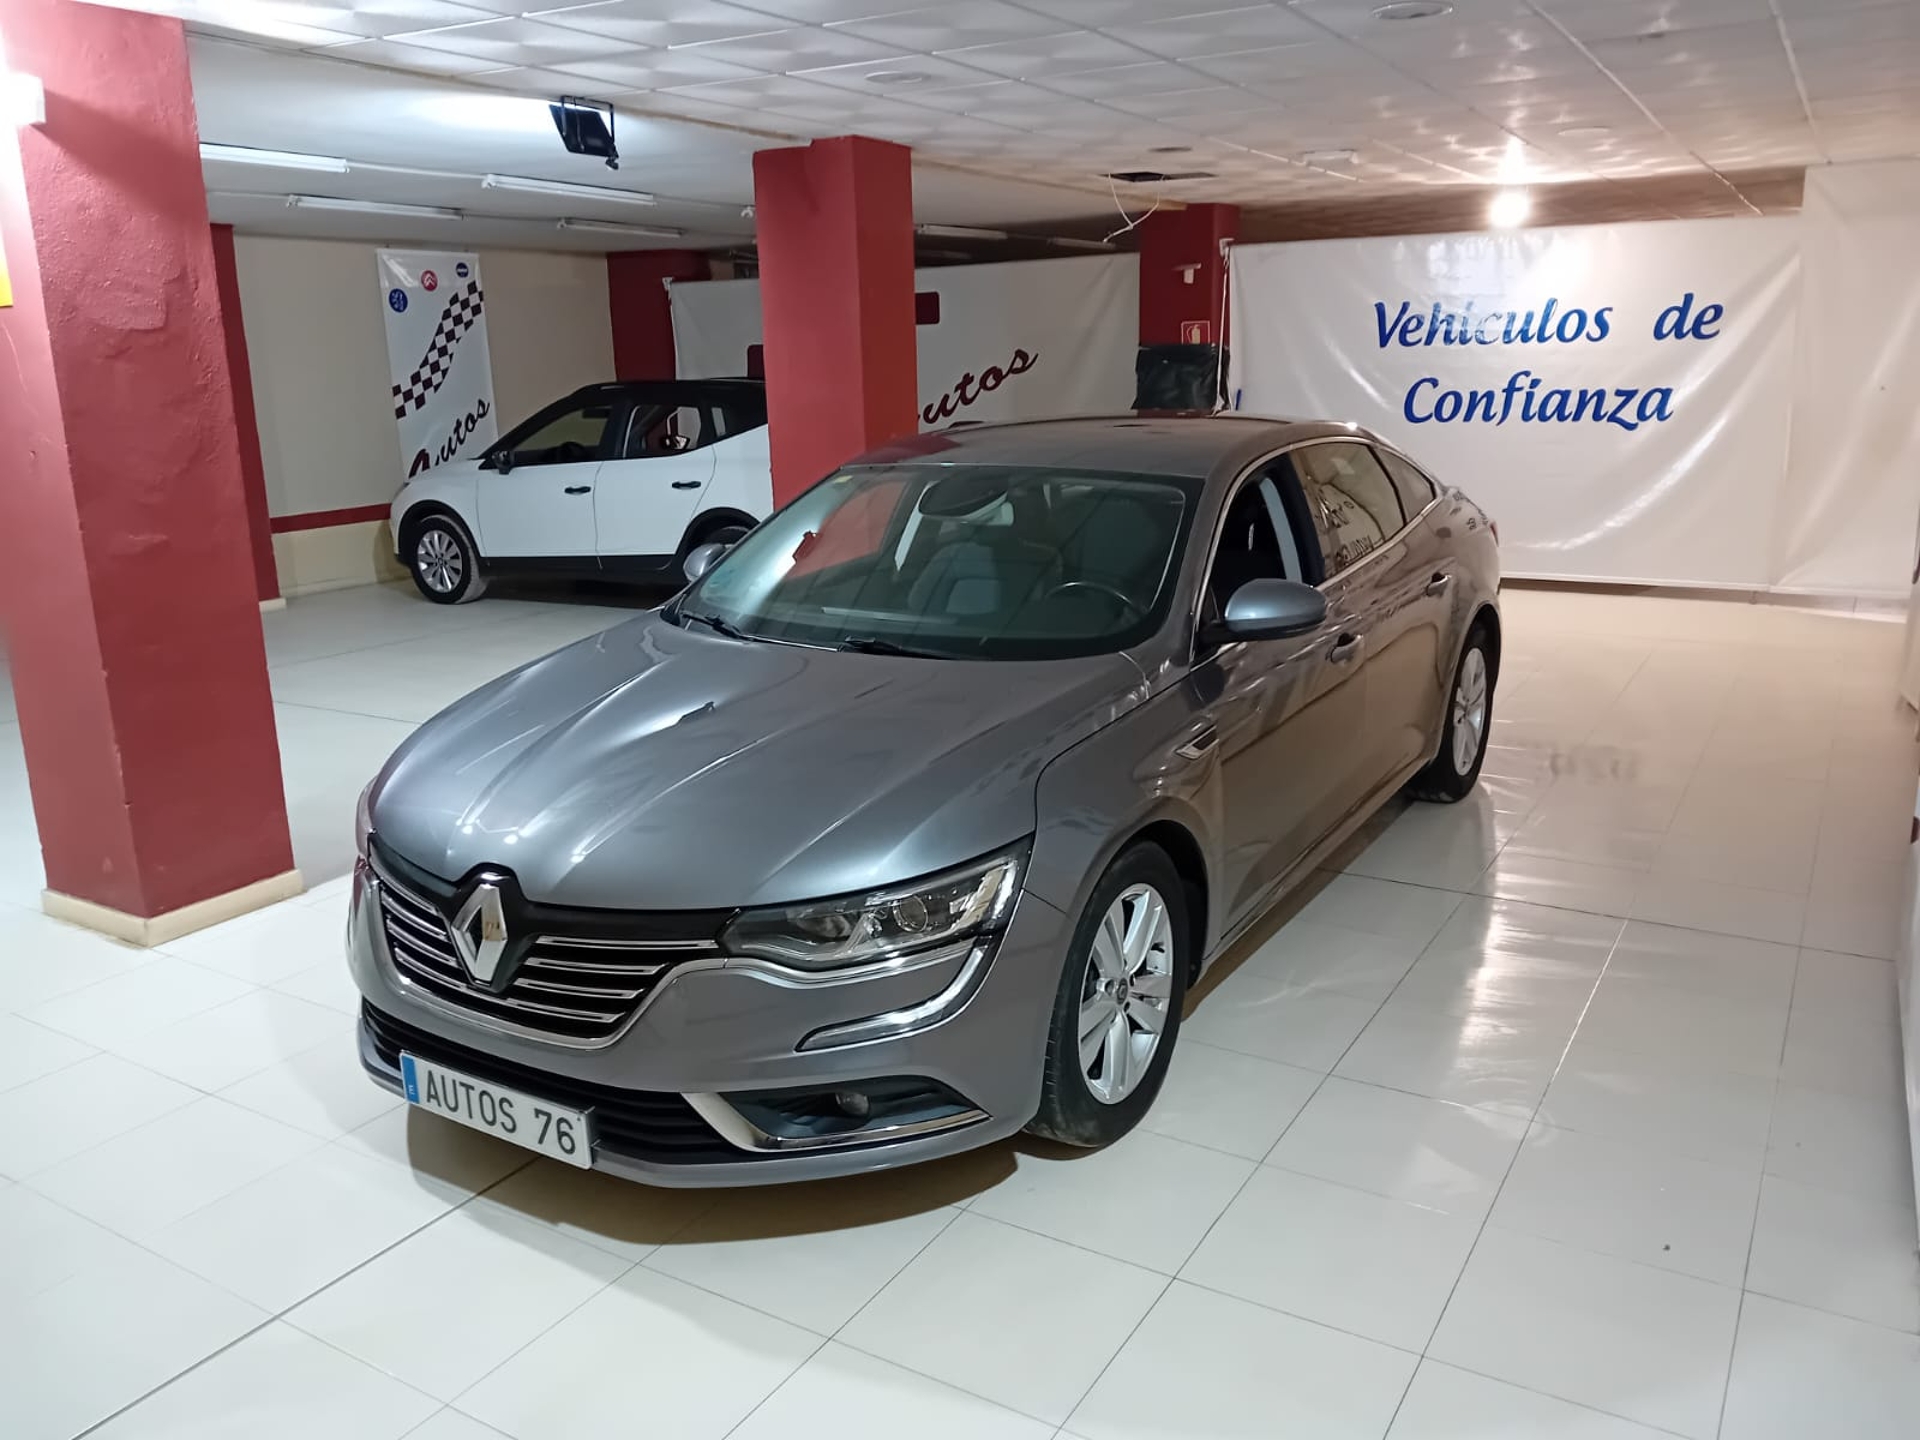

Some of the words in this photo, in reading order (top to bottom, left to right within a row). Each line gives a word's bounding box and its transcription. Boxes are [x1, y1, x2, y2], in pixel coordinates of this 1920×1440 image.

[1653, 293, 1724, 341] de
[918, 349, 1039, 424] utos
[1403, 370, 1674, 431] Confianza
[426, 1070, 517, 1134] AUTOS
[534, 1107, 576, 1155] 76
